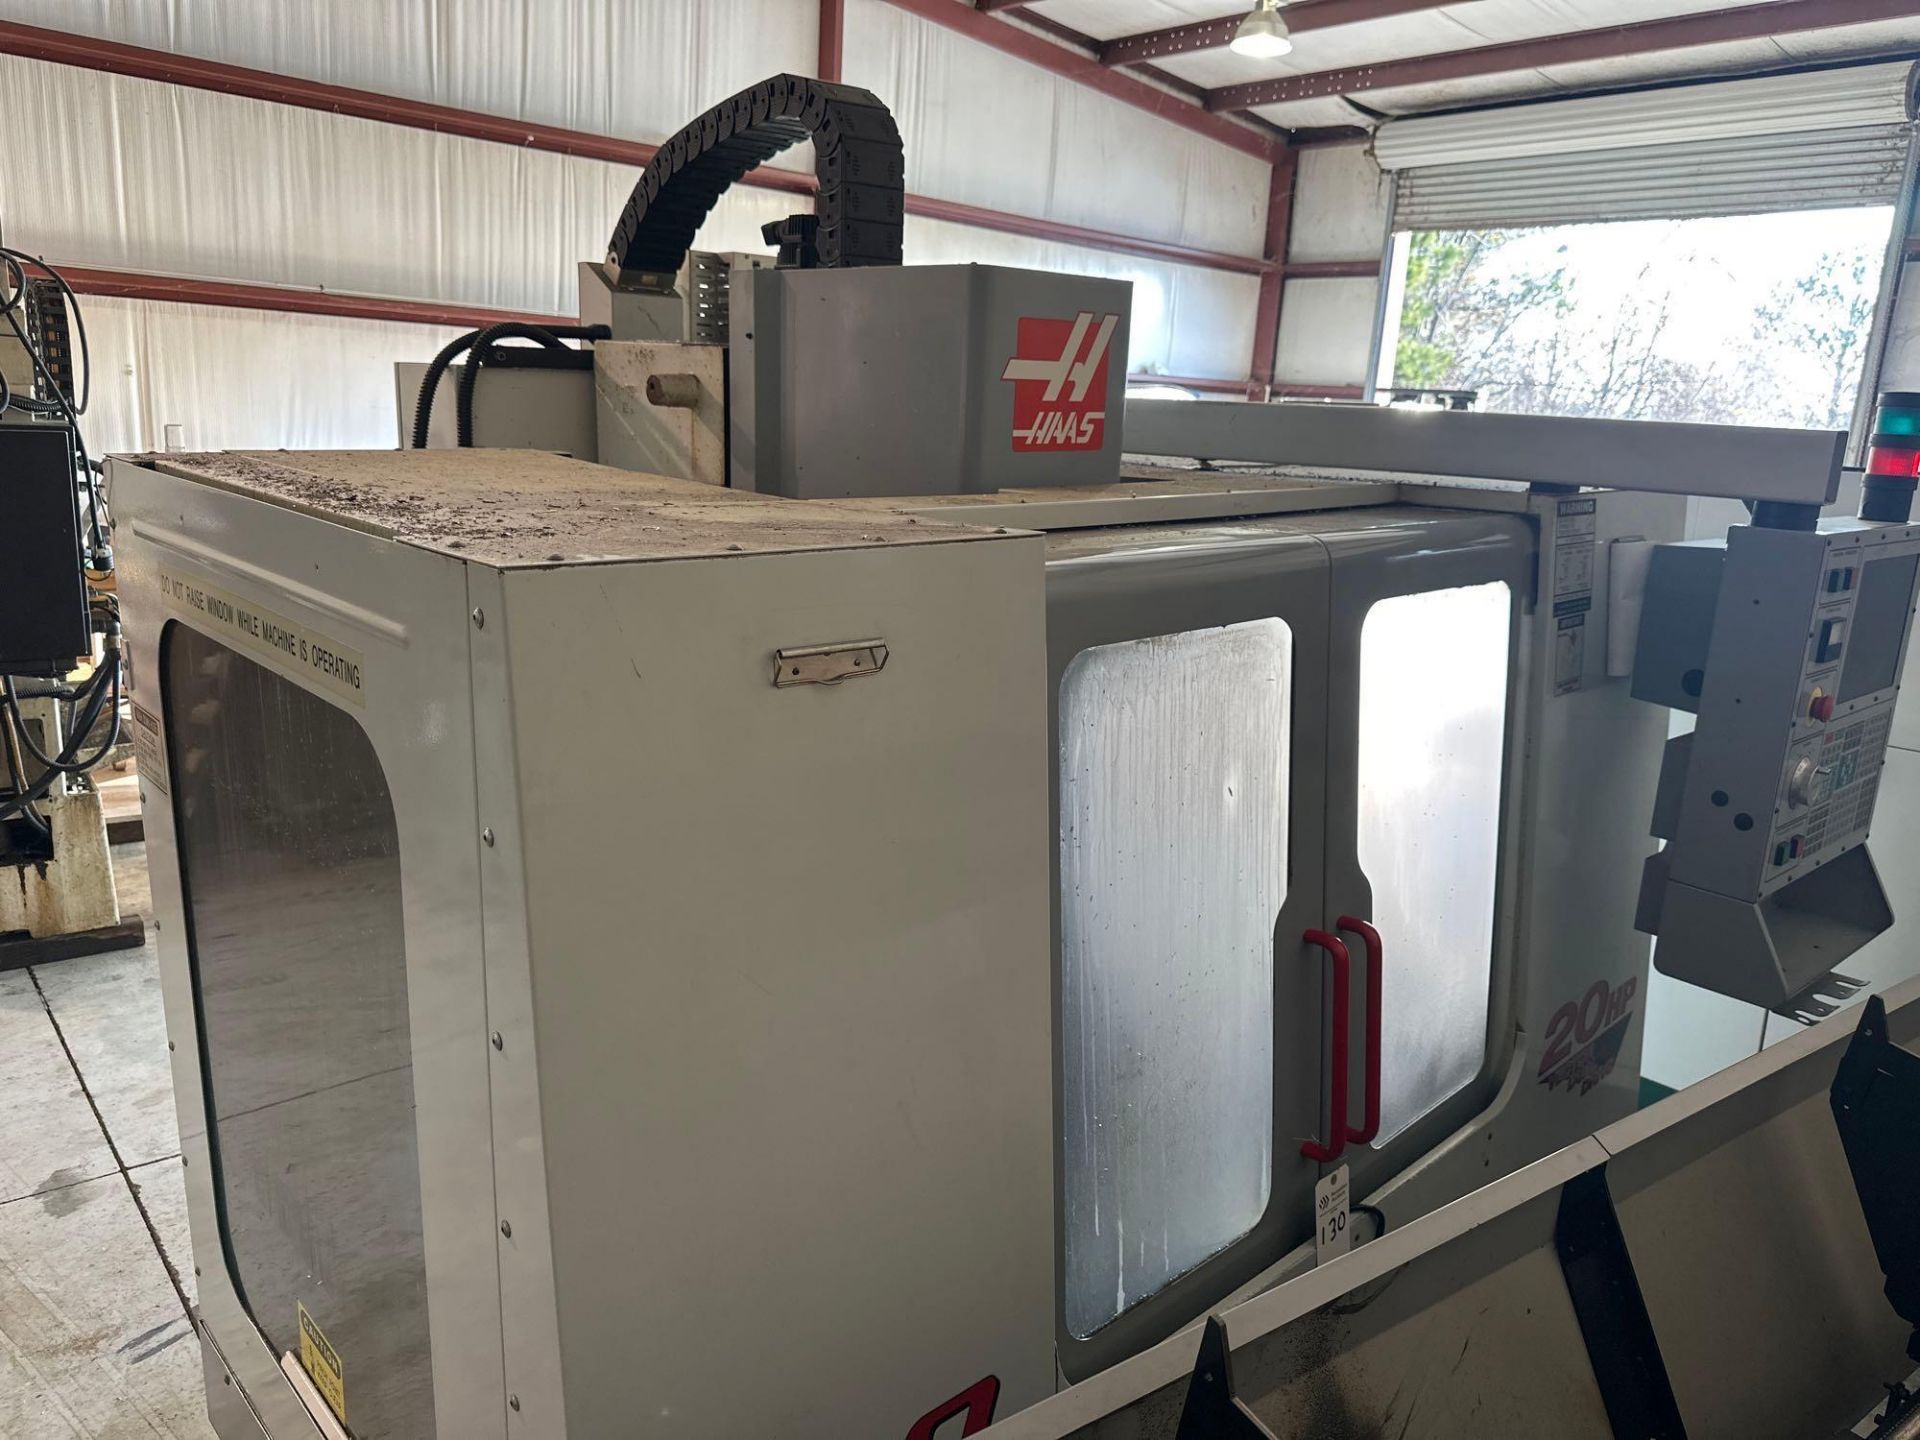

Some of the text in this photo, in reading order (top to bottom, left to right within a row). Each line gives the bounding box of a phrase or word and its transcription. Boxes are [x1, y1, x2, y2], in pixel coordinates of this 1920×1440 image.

[1012, 411, 1105, 445] HAAS
[161, 575, 361, 689] DO NOT RAISE WINDOW WHILE MACHINE IS OPERATING
[1321, 1210, 1346, 1246] 130
